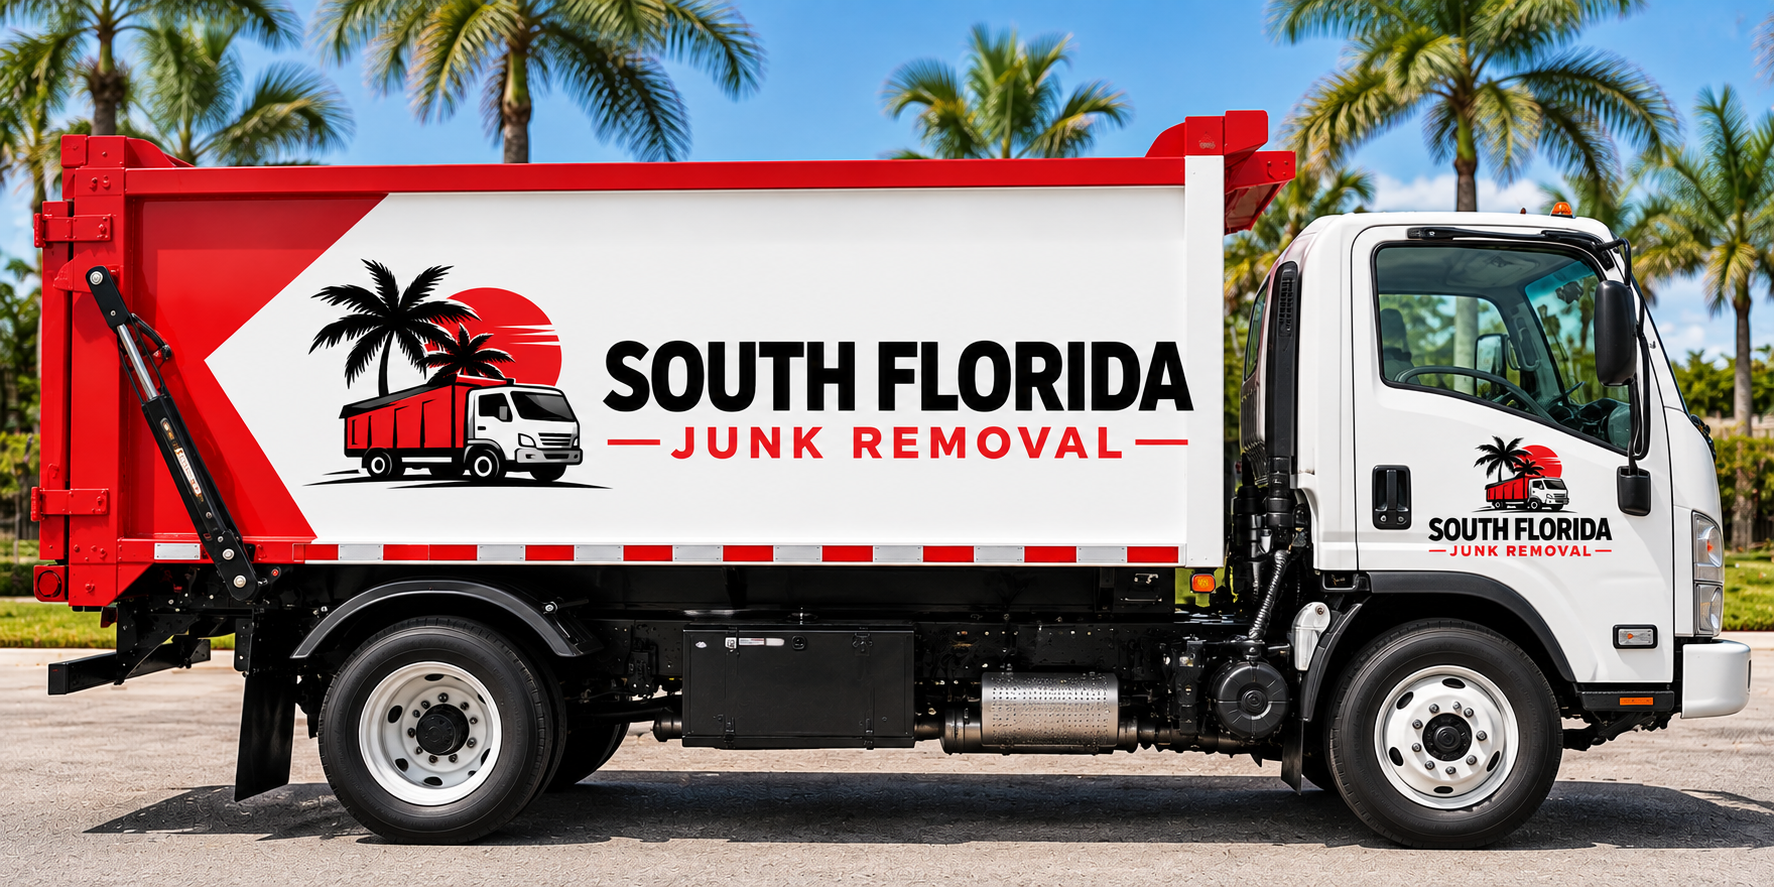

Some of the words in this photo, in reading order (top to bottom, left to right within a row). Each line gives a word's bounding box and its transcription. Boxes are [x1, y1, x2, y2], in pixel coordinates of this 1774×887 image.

[602, 340, 856, 413] SOUTH
[878, 340, 1195, 413] FLORIDA
[670, 426, 824, 460] JUNK
[853, 426, 1123, 460] REMOVAL
[1428, 517, 1509, 541] SOUTH
[1514, 517, 1613, 541] FLORIDA
[1449, 545, 1499, 557] JUNK
[1506, 545, 1592, 557] REMOVAL
